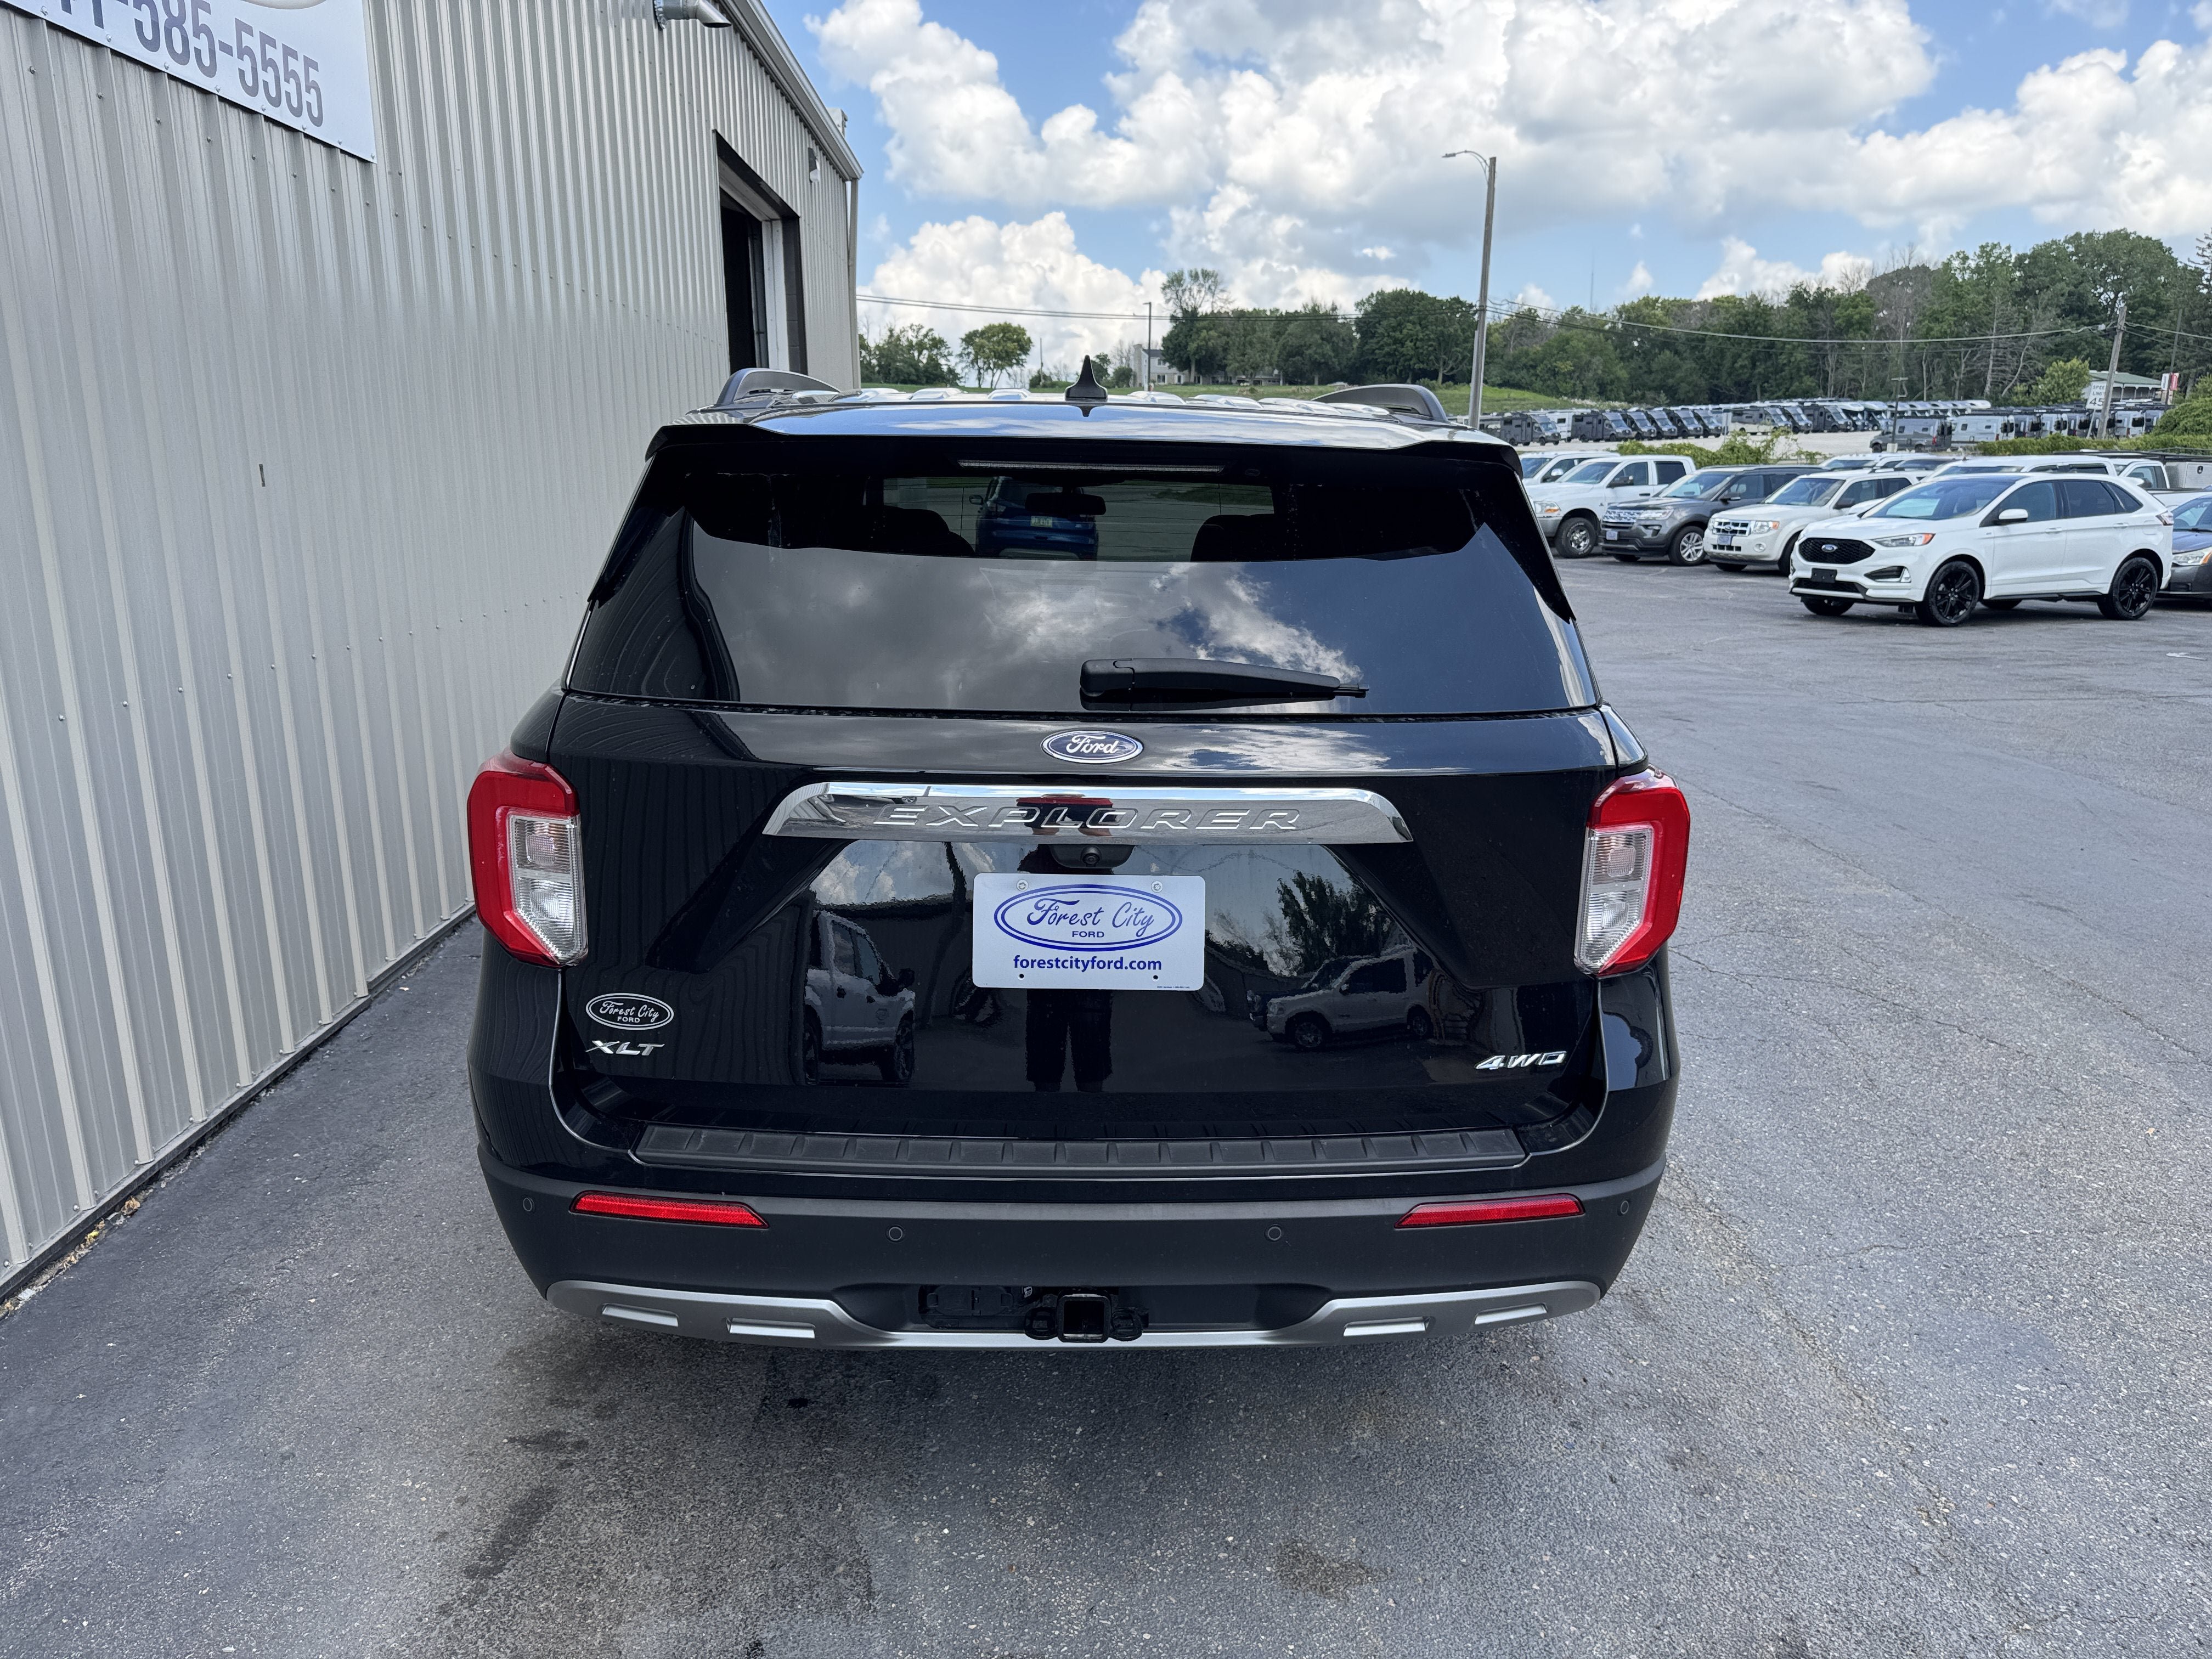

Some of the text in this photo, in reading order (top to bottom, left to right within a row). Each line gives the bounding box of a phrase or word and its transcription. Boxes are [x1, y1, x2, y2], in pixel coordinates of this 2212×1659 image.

[61, 0, 324, 127] -585-5555
[2089, 397, 2105, 407] 45
[1066, 735, 1119, 754] Ford
[873, 805, 1301, 830] EXPLORER
[1026, 898, 1154, 938] Forest City
[1013, 955, 1162, 973] forestcityford.com
[599, 1001, 659, 1023] Forest City
[585, 1040, 665, 1056] XLT
[1474, 1051, 1567, 1070] 4WD
